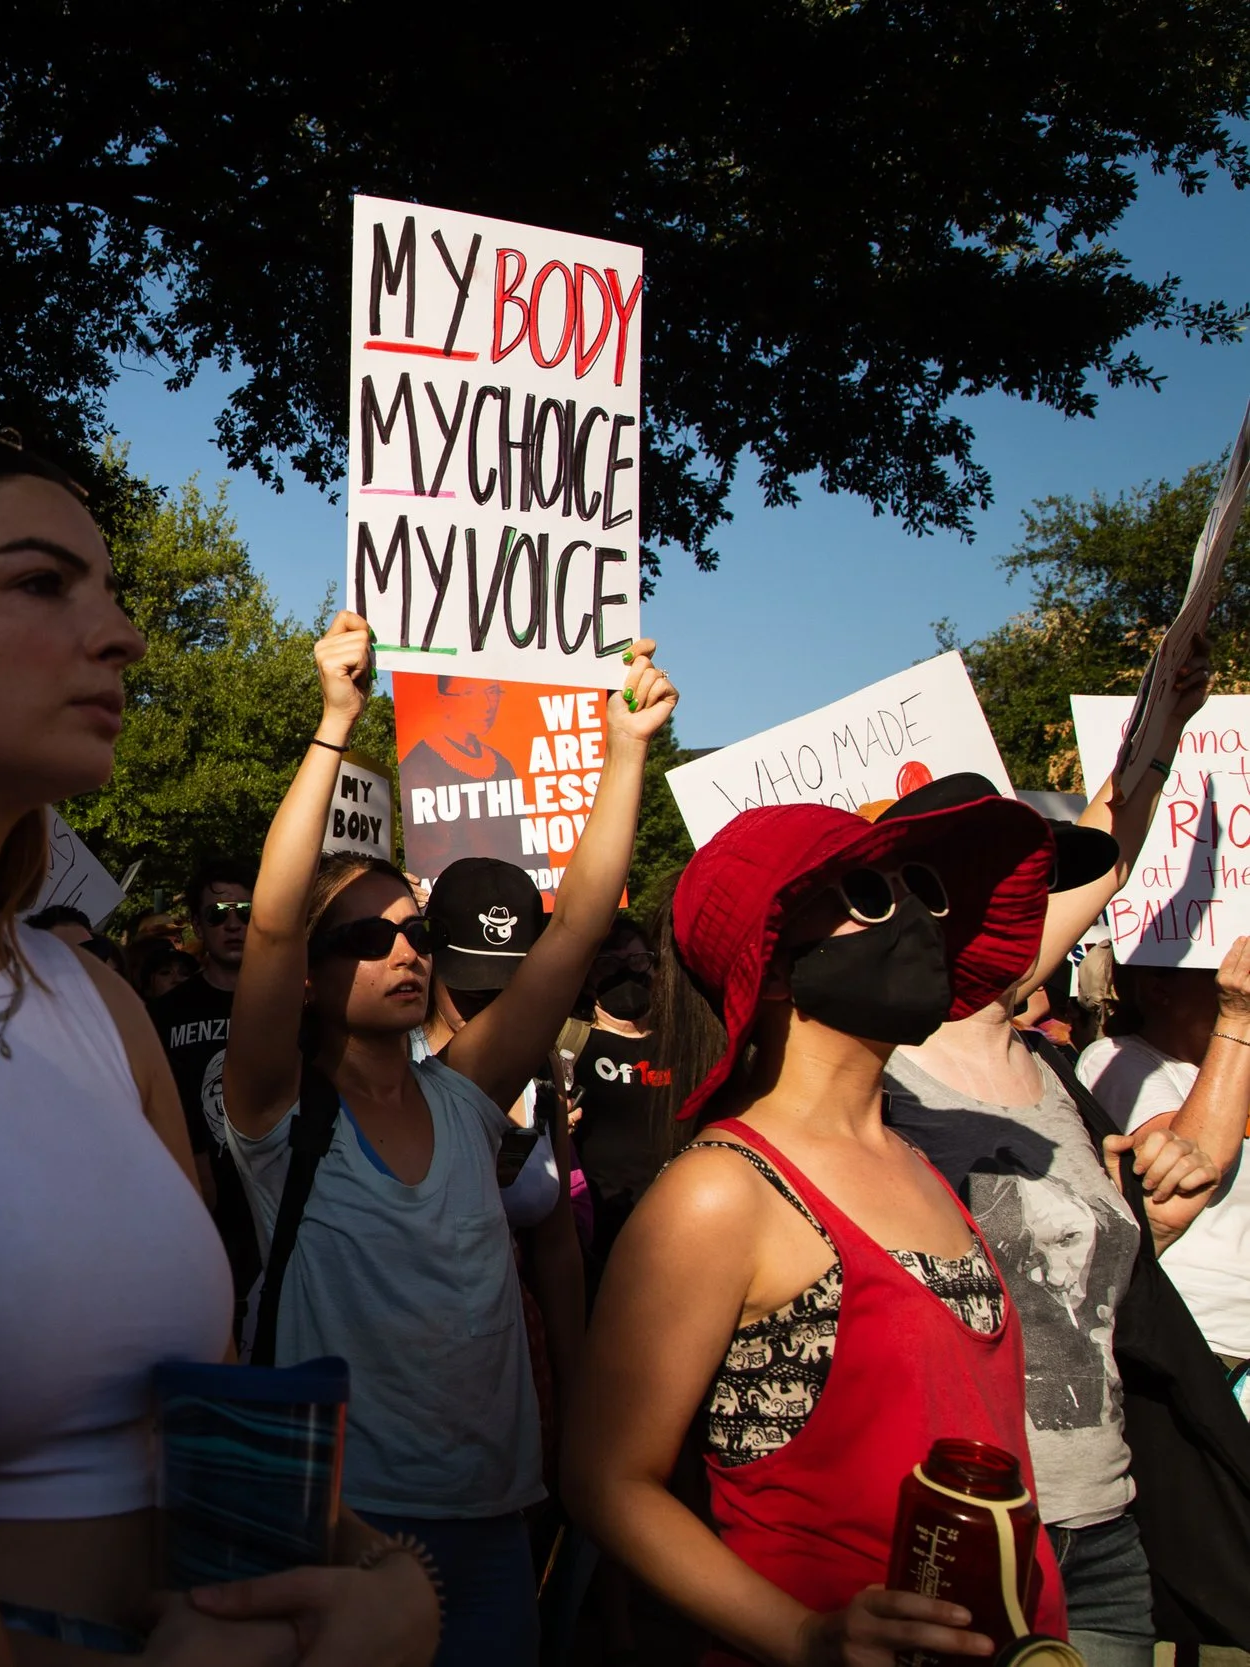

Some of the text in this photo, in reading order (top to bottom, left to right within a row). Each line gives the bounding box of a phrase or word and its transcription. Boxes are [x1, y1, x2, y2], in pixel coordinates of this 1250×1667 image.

[370, 216, 642, 387] MY BODY
[363, 372, 635, 530] MY CHOICE
[355, 515, 634, 658] MY VOICE
[538, 692, 601, 732] WE
[528, 732, 604, 774] ARE
[712, 692, 932, 815] WHO MADE
[341, 775, 373, 803] MY
[411, 772, 603, 825] RUTHLESS
[333, 809, 382, 846] BODY
[1141, 855, 1181, 888] at
[1110, 898, 1223, 947] BALLOT
